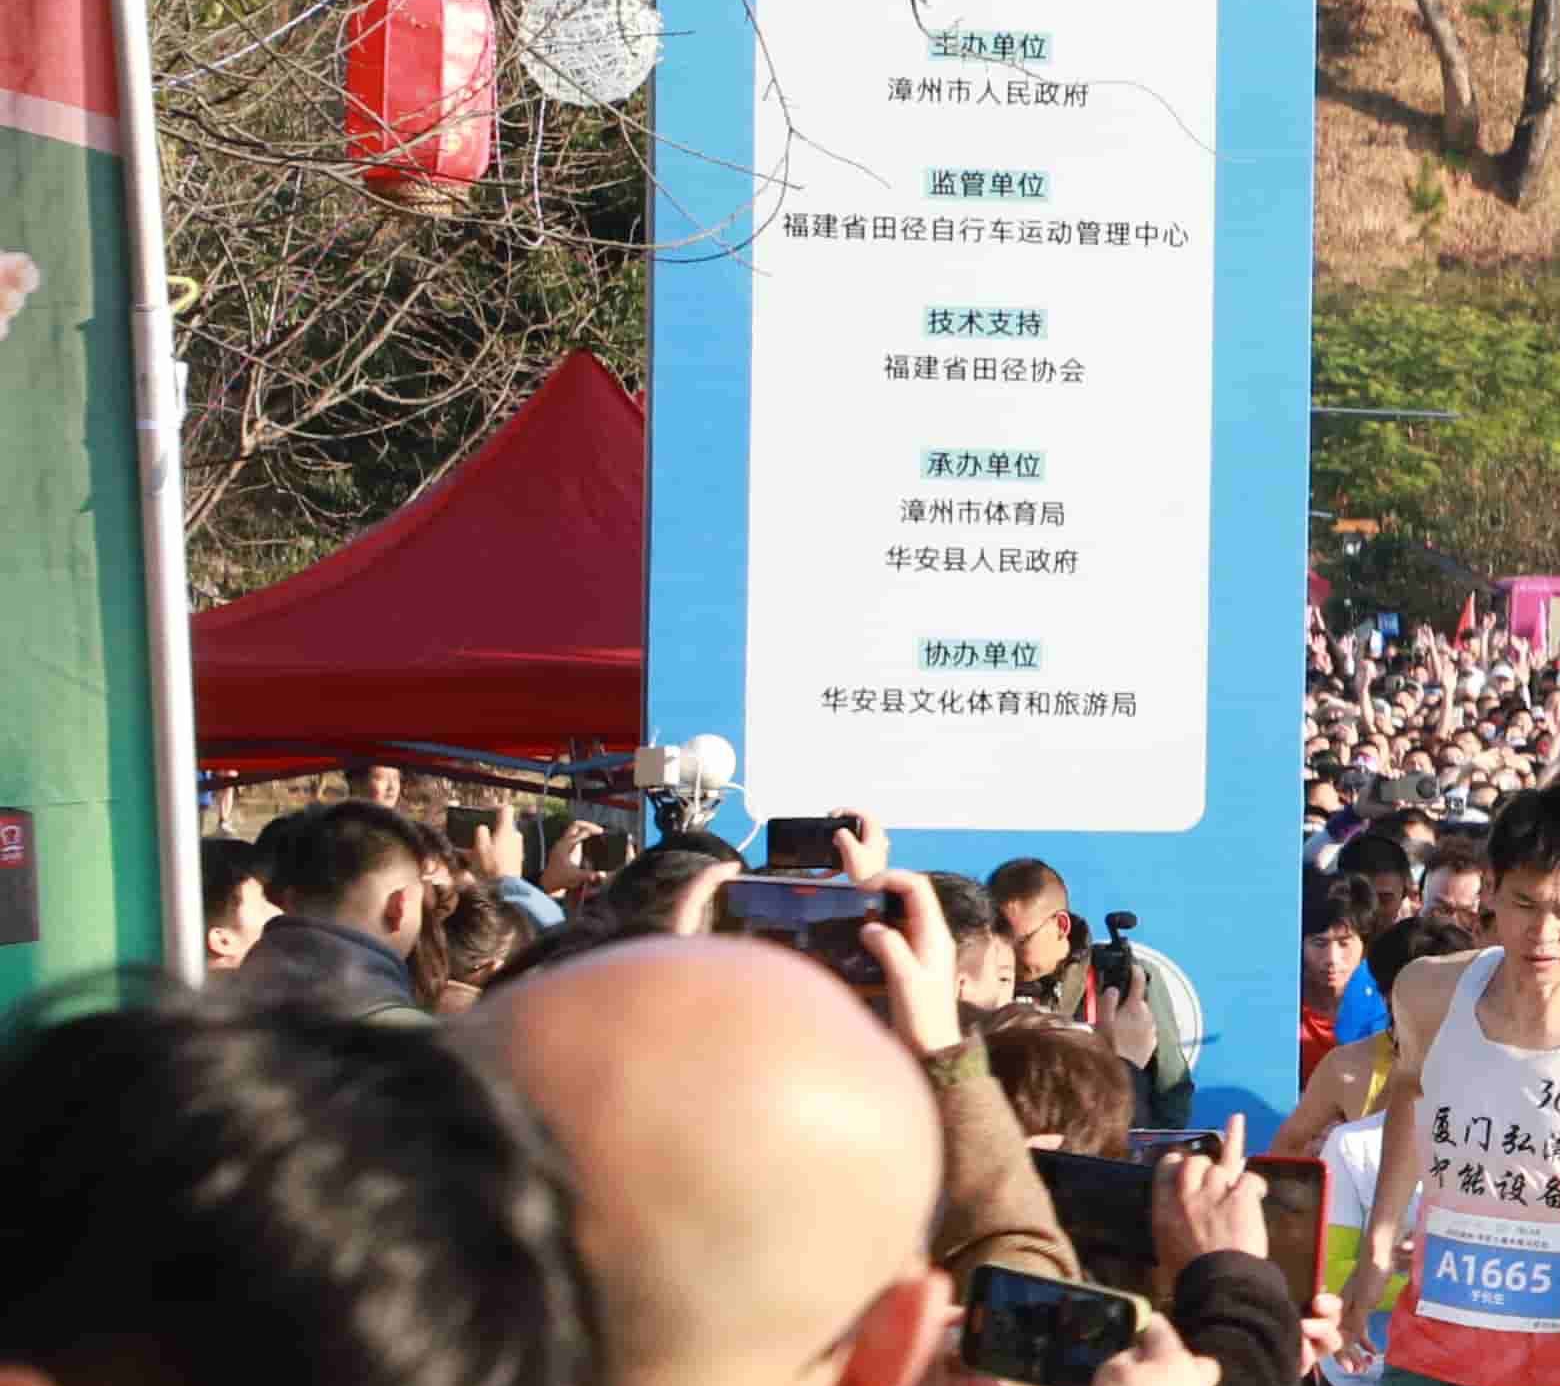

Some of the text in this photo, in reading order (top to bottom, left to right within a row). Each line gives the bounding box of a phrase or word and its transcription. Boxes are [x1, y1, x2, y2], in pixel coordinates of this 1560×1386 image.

[930, 33, 1047, 60] 主办单位
[888, 77, 1089, 107] 漳州市人民政府
[930, 171, 1046, 198] 监管单位
[782, 213, 1189, 248] 福建省田径自行车运动管理中心
[928, 310, 1042, 336] 技术支持
[884, 354, 1086, 383] 福建省田径协会
[927, 452, 1040, 478] 承办单位
[901, 499, 1065, 527] 漳州市体育局
[885, 545, 1078, 575] 华安县人民政府
[925, 641, 1038, 668] 协办单位
[821, 687, 1137, 718] 华安县文化体育和旅游局
[1436, 1250, 1552, 1294] A1665
